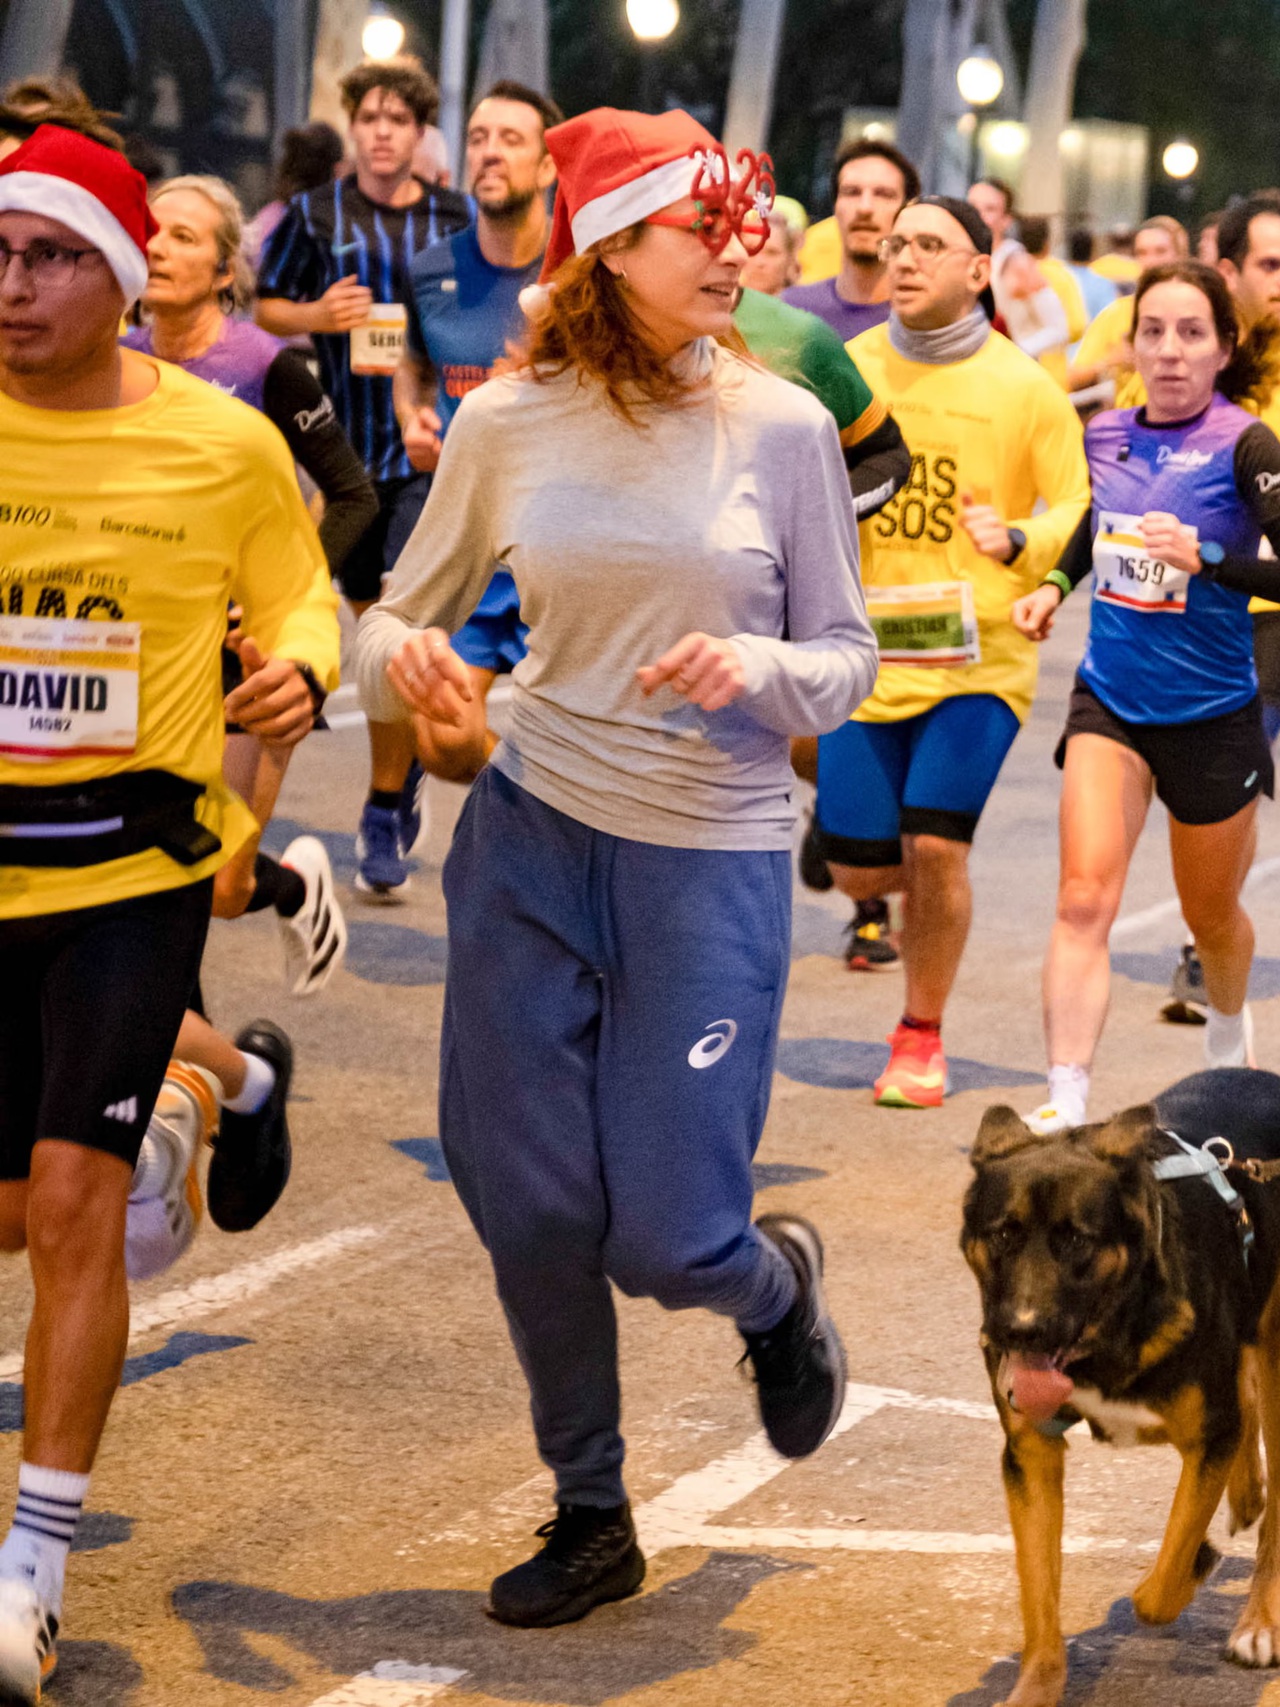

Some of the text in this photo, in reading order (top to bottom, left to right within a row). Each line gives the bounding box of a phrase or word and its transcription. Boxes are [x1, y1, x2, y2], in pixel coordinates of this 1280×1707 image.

[904, 452, 957, 499] AS
[1115, 555, 1166, 586] 1659
[0, 670, 108, 713] DAVID
